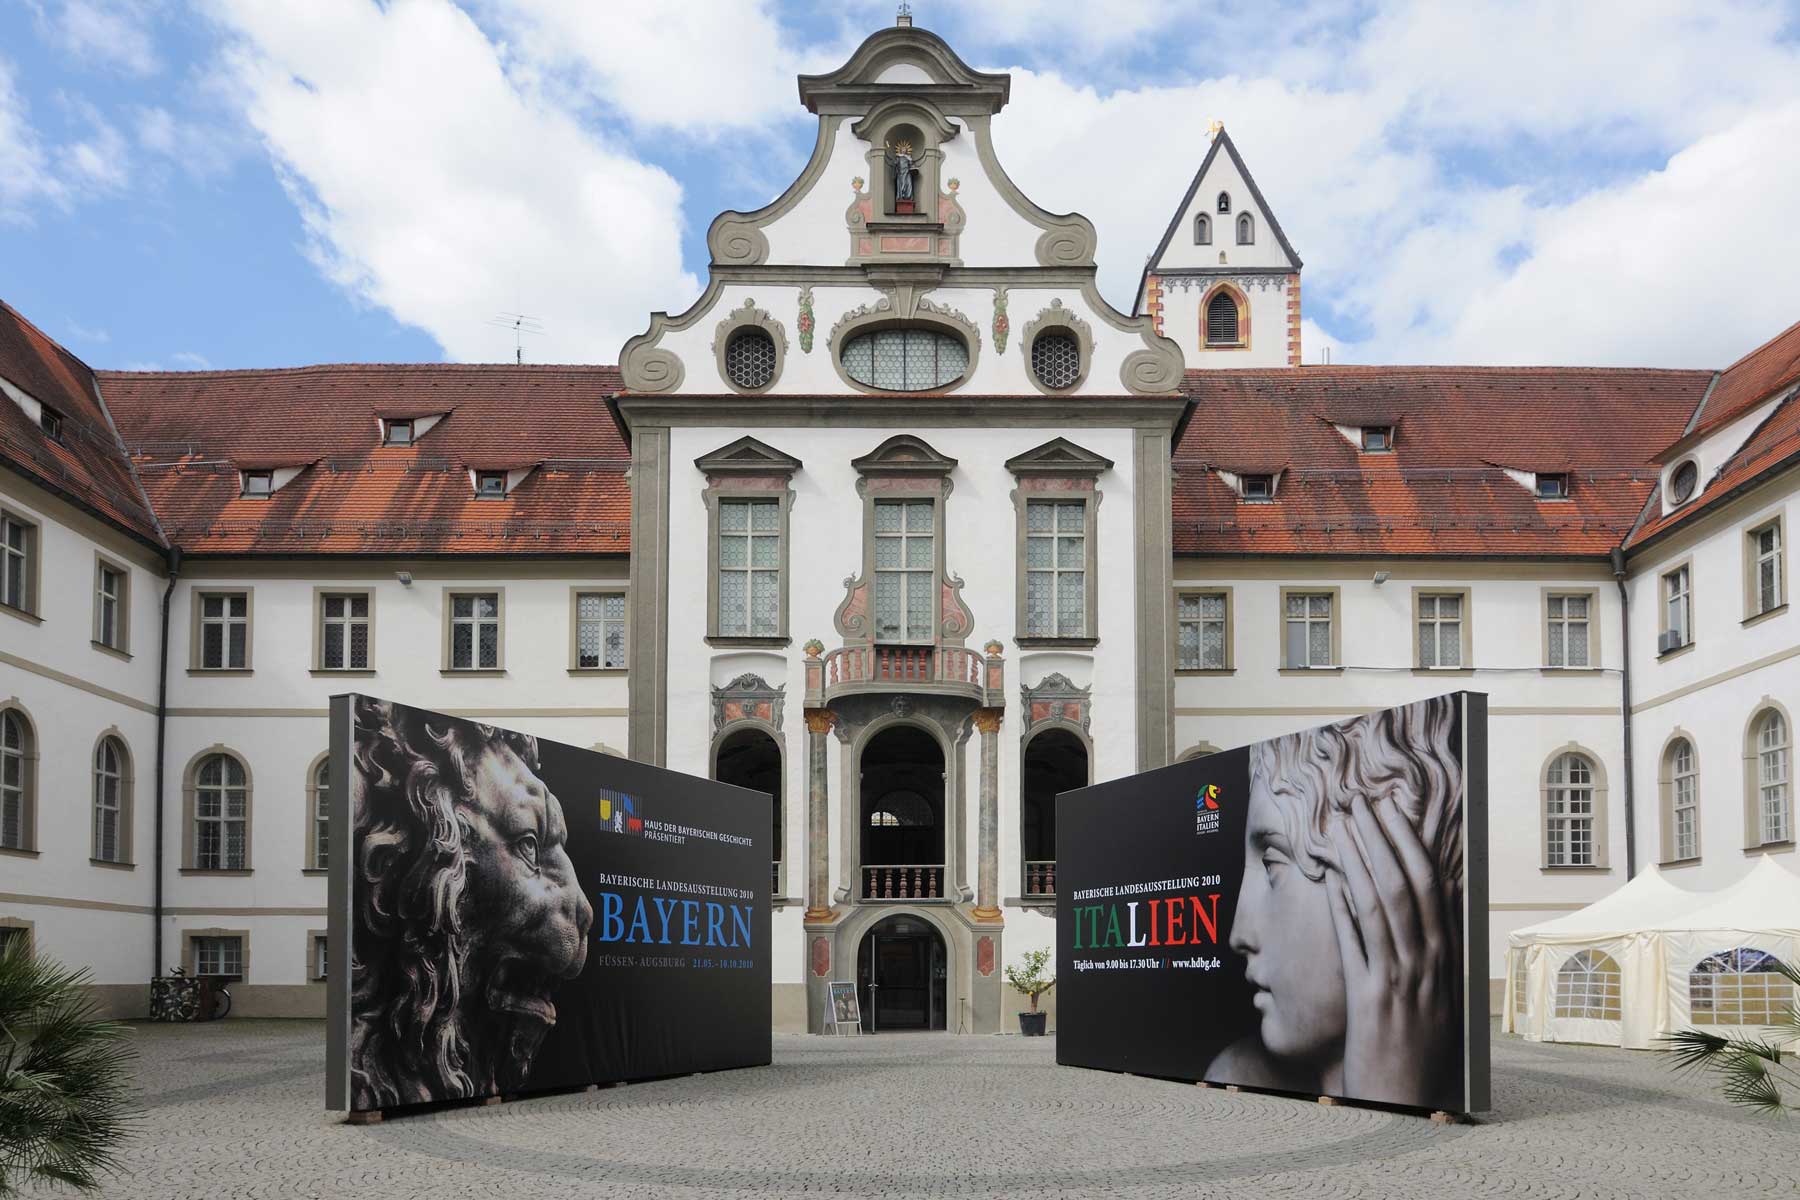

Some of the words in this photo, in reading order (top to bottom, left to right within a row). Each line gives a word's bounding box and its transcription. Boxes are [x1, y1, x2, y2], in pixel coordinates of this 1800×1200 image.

[1196, 812, 1220, 824] BAYERN
[1196, 820, 1220, 832] ITALIEN
[644, 819, 663, 831] HAUS
[664, 822, 680, 833] DER
[678, 825, 718, 841] BAYERISCHEN
[719, 833, 753, 847] GESCHICHTE
[644, 830, 686, 845] PRÄSENTIERT
[600, 873, 655, 889] BAYERISCHE
[656, 879, 738, 898] LANDESAUSSTELLUNG
[739, 889, 754, 900] 2010
[1073, 886, 1114, 900] BAYERISCHE
[1115, 876, 1200, 896] LANDESAUSSTELLUNG
[1201, 874, 1221, 886] 2010
[600, 892, 753, 948] BAYERN
[1073, 894, 1221, 949] ITALIEN
[640, 956, 686, 969] AUGSBURG
[1073, 959, 1094, 972] Täglich
[1094, 962, 1105, 970] von
[1106, 960, 1119, 969] 9.00
[1119, 959, 1129, 969] bis
[1129, 959, 1146, 969] 17.30
[1146, 958, 1160, 969] Uhr
[1172, 957, 1221, 971] www.hdbg.de
